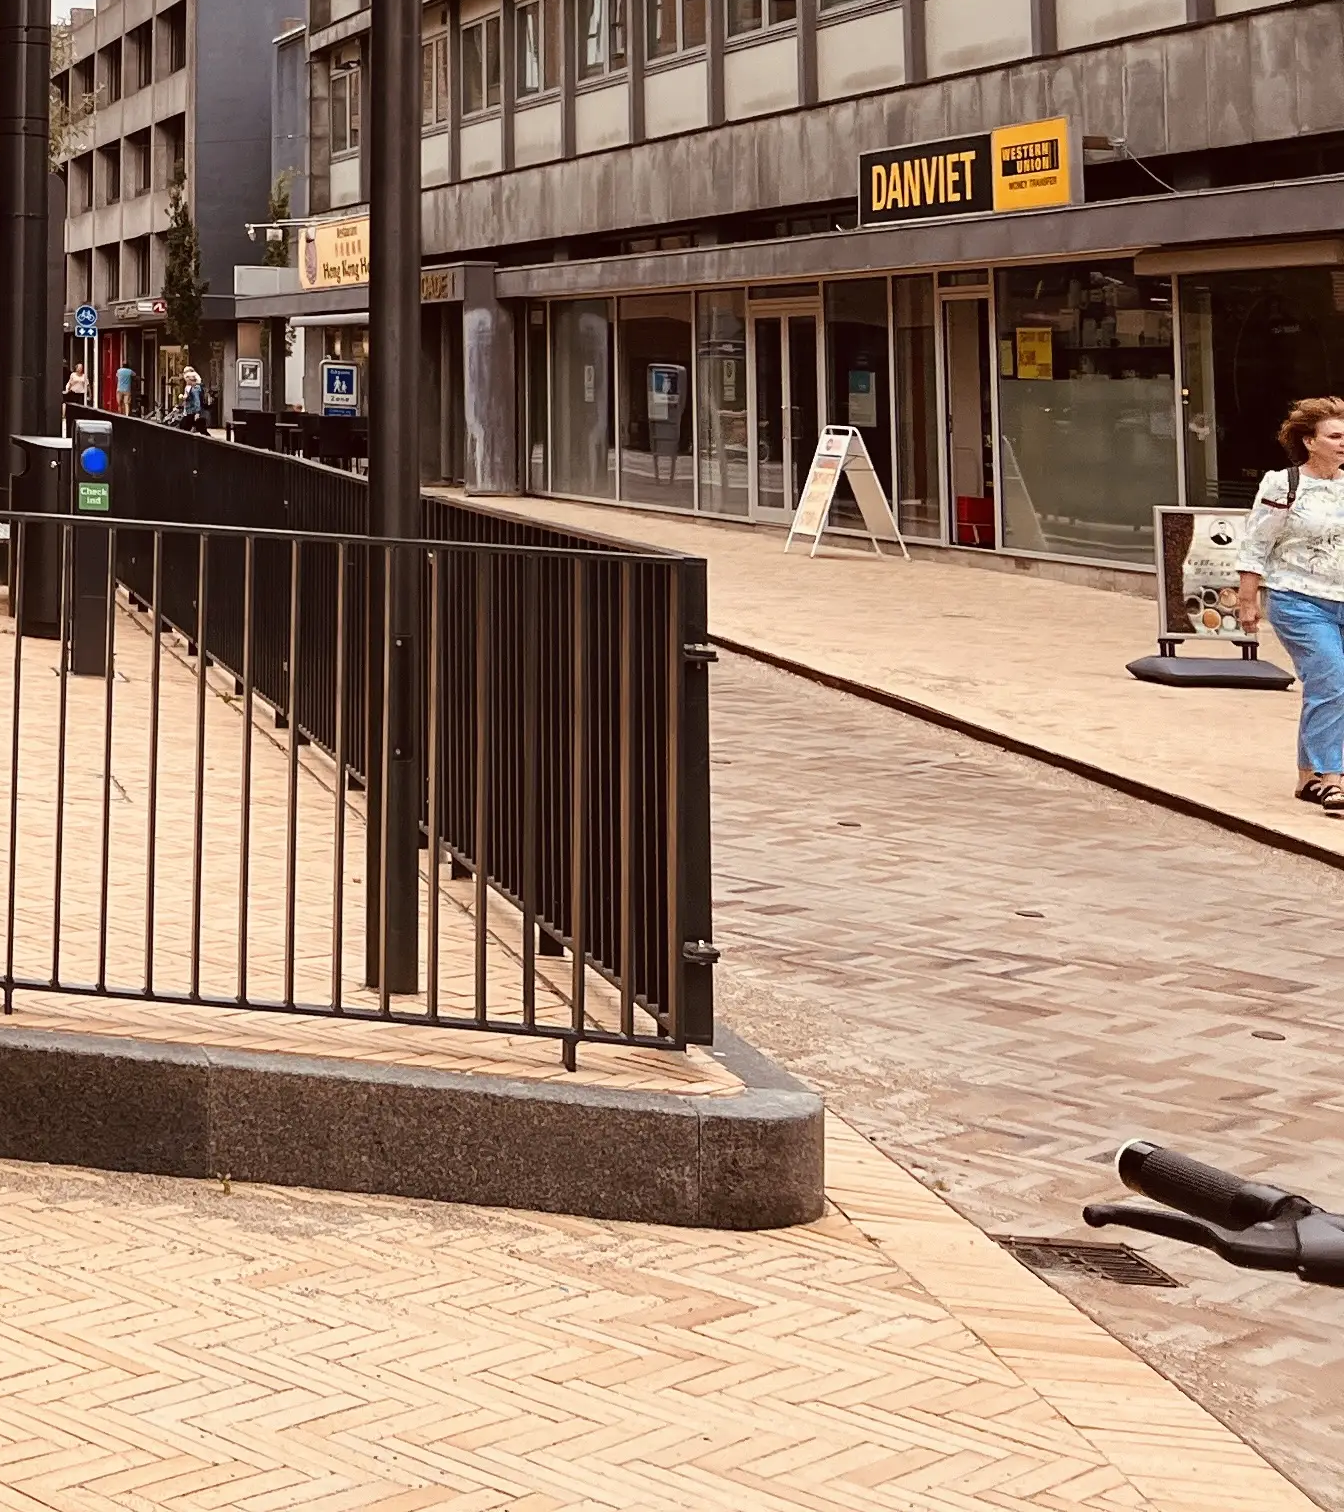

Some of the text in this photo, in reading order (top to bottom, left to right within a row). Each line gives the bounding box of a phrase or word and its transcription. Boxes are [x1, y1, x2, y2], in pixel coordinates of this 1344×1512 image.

[1002, 142, 1049, 161] WESTERN
[1016, 156, 1050, 174] UNION
[872, 150, 976, 211] DANVIET
[80, 487, 108, 496] Check
[86, 497, 102, 505] ind
